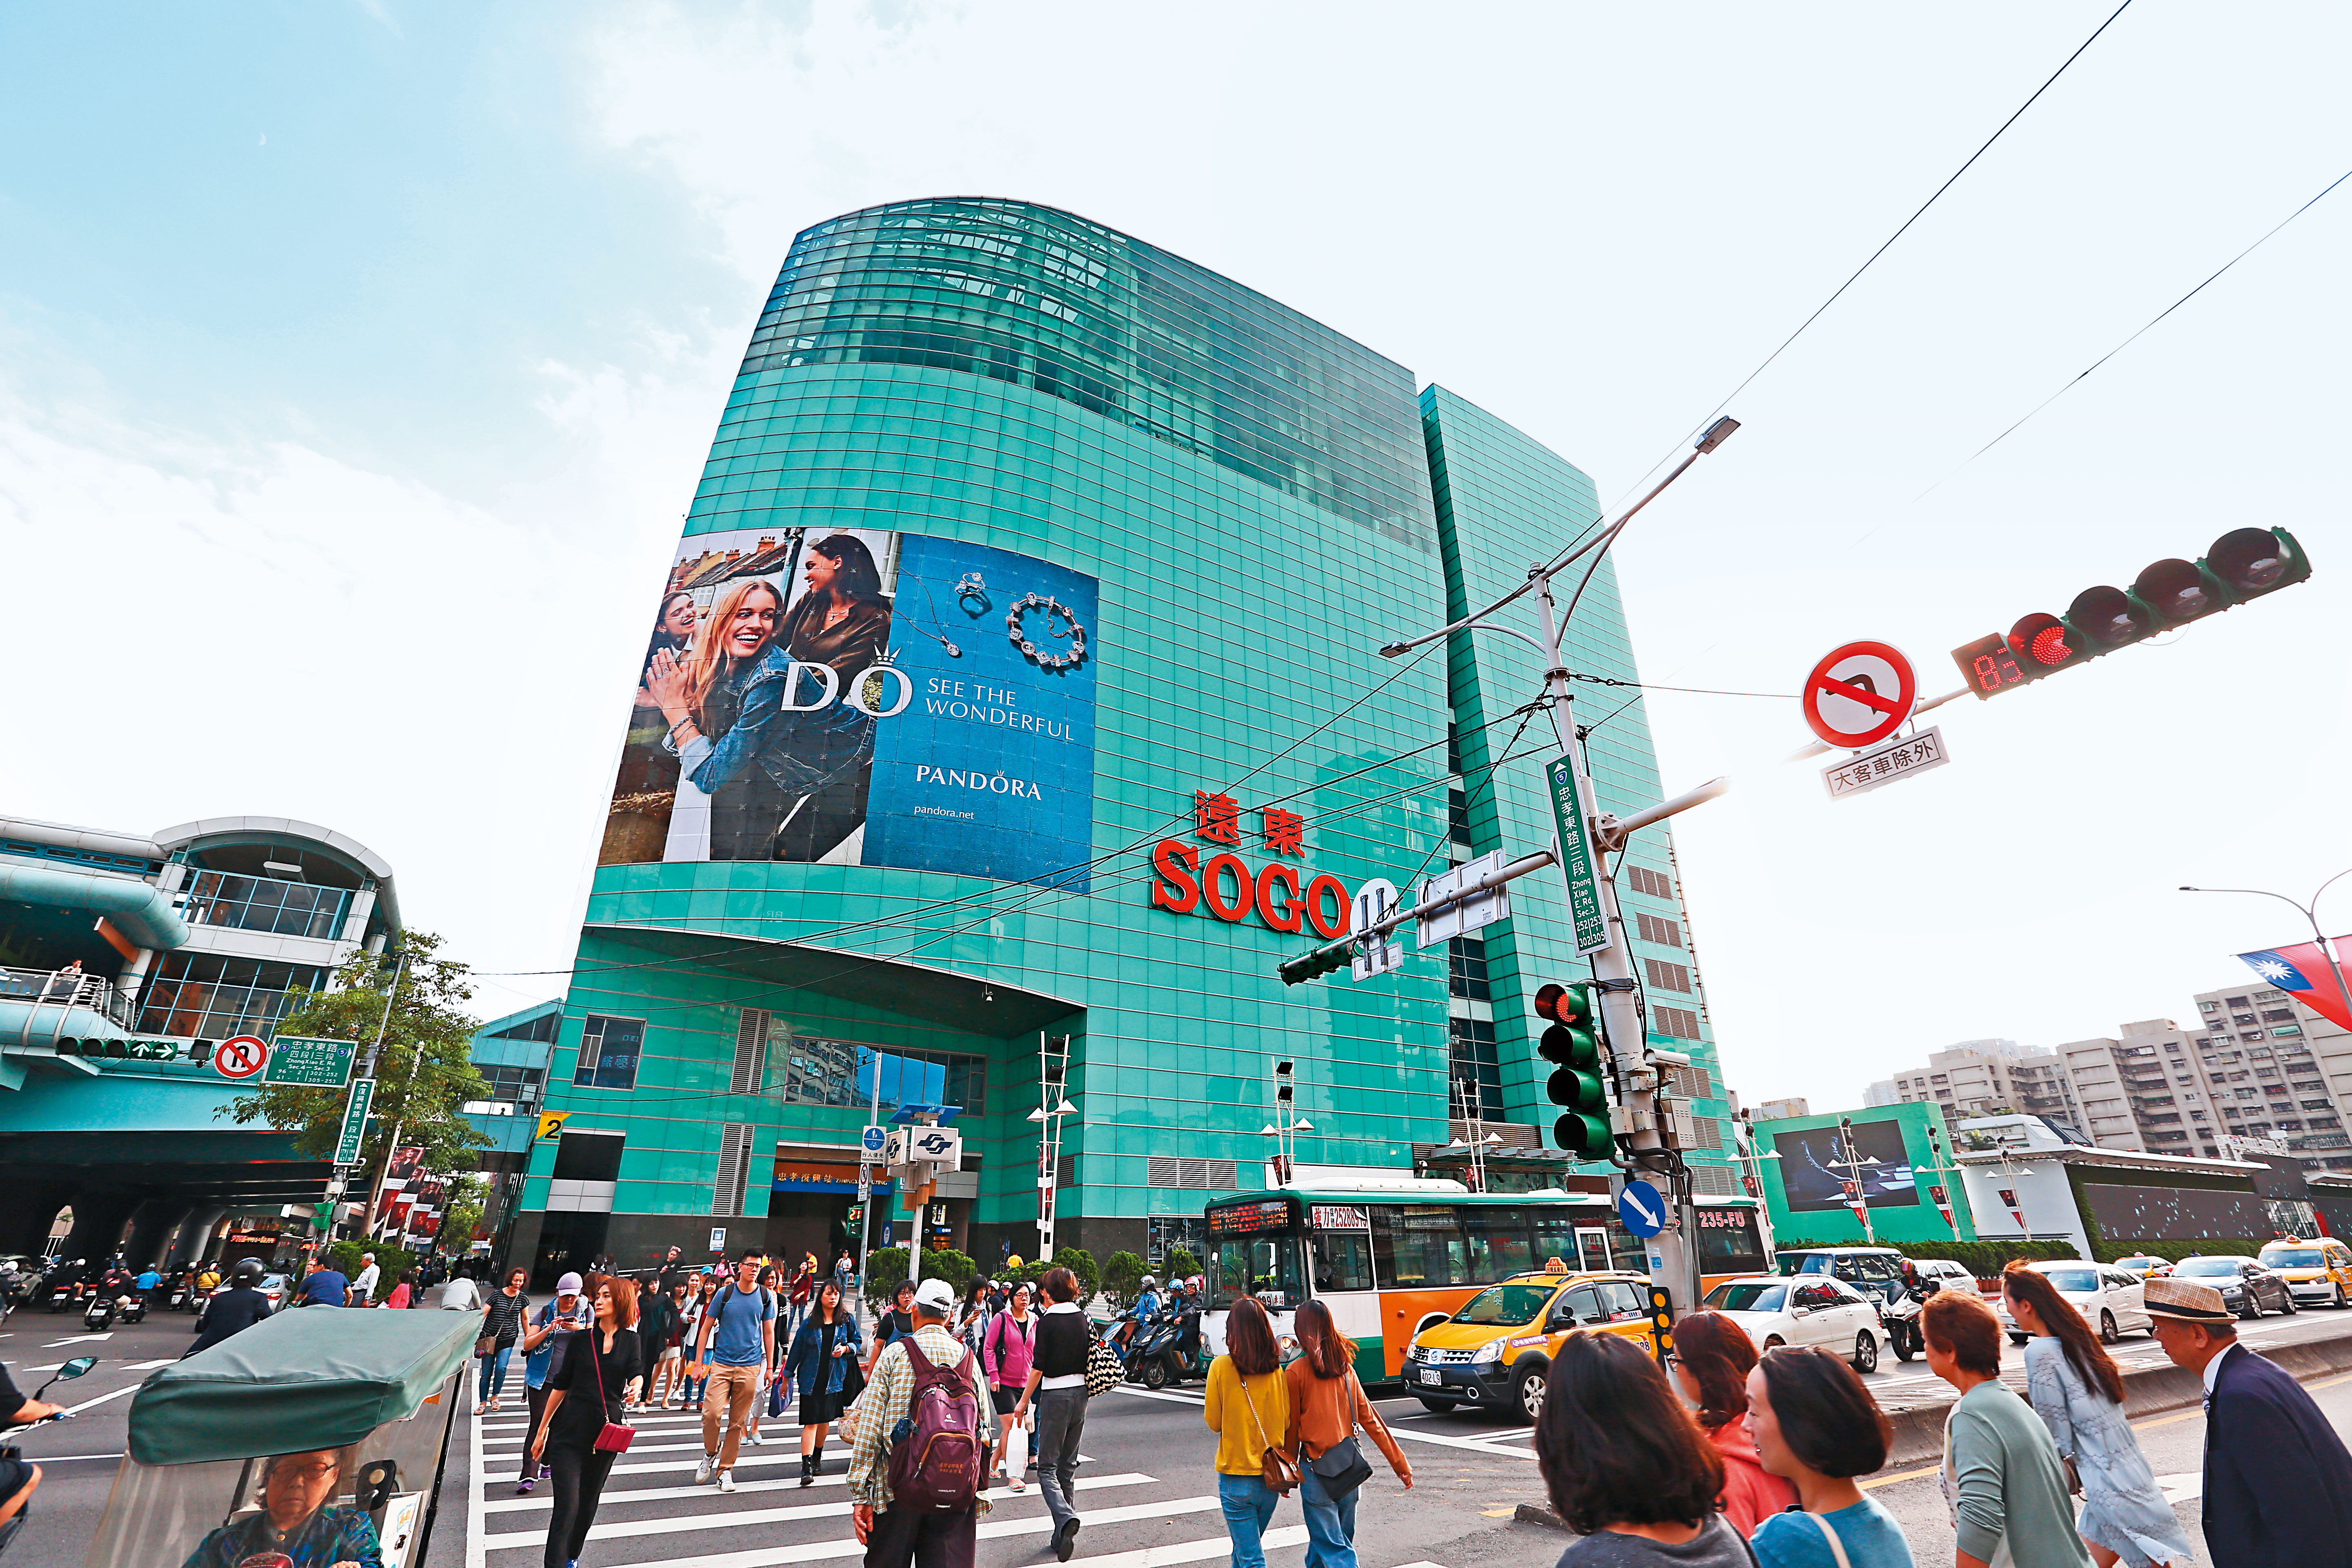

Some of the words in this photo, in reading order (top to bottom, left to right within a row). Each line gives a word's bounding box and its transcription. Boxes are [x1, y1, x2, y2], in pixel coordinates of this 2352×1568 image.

[781, 662, 913, 717] DO
[927, 678, 964, 697] SEE
[973, 684, 1016, 707] THE
[926, 698, 1074, 741] WONDERFUL
[1834, 739, 1934, 791] 大客車除外
[916, 765, 1041, 801] PANDORA
[914, 806, 974, 820] pandora.net
[1196, 788, 1305, 858] 遠東
[1558, 786, 1586, 877] 忠孝東路三段
[1153, 840, 1351, 939] SOGO
[1572, 878, 1592, 890] Zhong
[1574, 889, 1588, 899] Xiao
[1575, 901, 1582, 909] E.
[1583, 898, 1593, 906] Rd.
[1577, 906, 1595, 918] Sec.3
[1576, 920, 1588, 931] 252
[1590, 915, 1602, 927] 253
[1579, 936, 1591, 948] 302
[1593, 931, 1605, 944] 305
[291, 1041, 338, 1053] 忠孝東路
[315, 1052, 334, 1060] 三段
[348, 1088, 366, 1133] 復興南路一段
[544, 1120, 562, 1139] 2
[777, 1172, 833, 1183] 忠孝復興站
[849, 1209, 862, 1220] 21
[1314, 1207, 1329, 1227] 強力
[1699, 1212, 1745, 1227] 235-FU
[1274, 1295, 1283, 1305] 車站
[1493, 1295, 1502, 1305] 安
[1422, 1373, 1440, 1383] 402-L9
